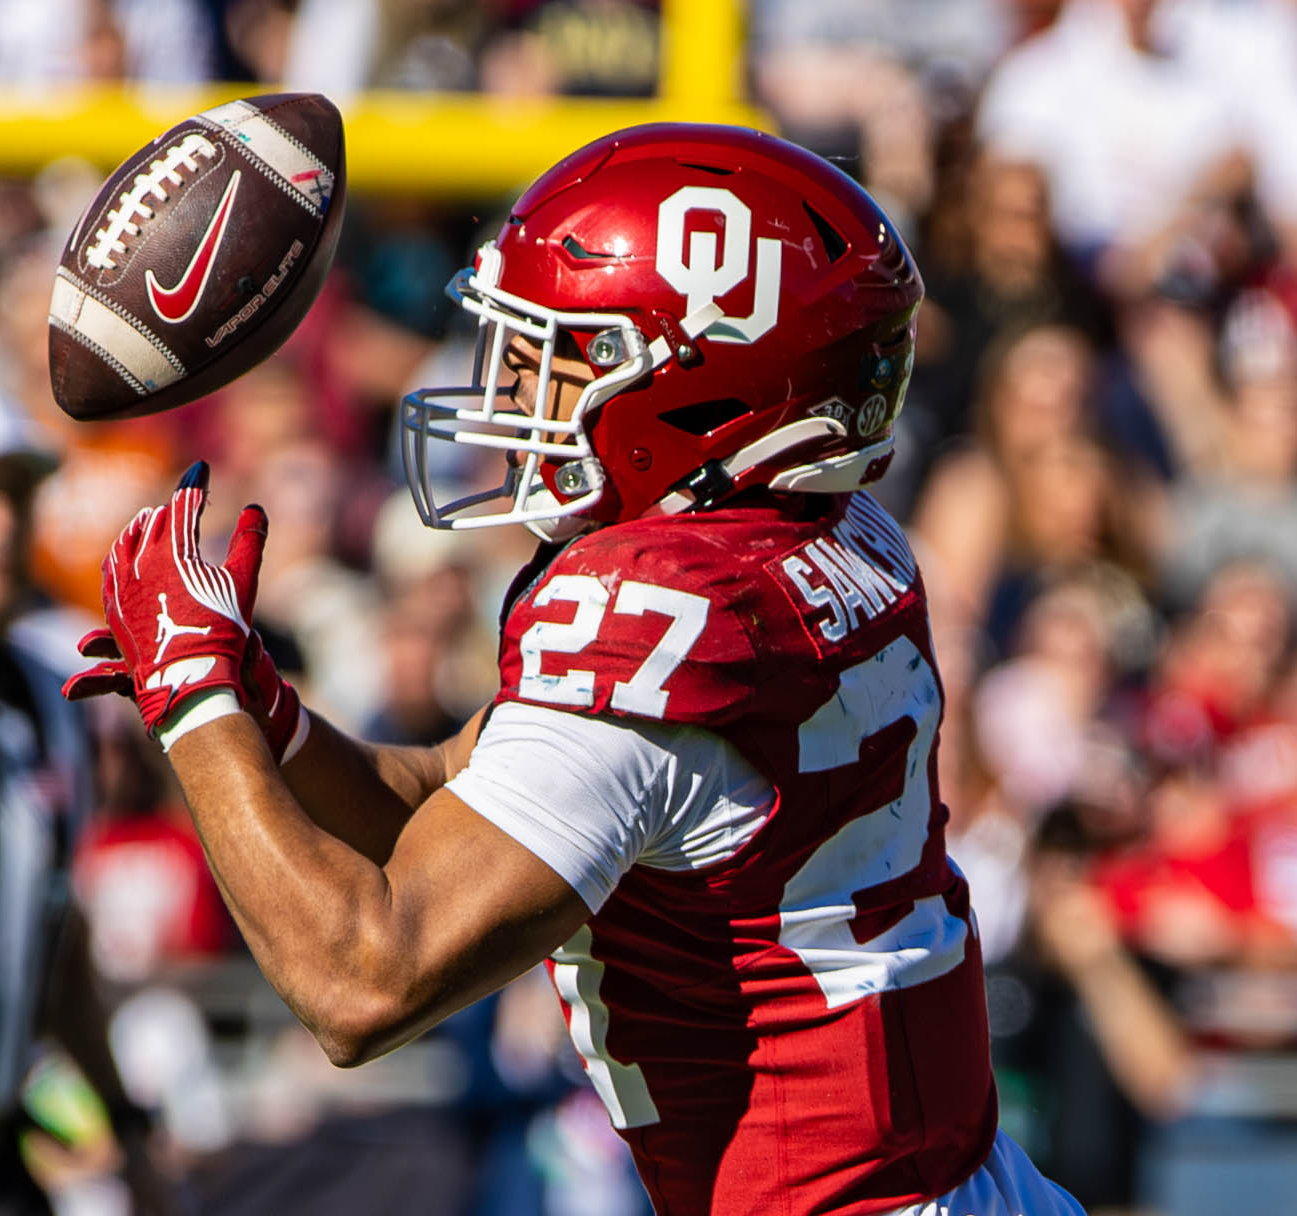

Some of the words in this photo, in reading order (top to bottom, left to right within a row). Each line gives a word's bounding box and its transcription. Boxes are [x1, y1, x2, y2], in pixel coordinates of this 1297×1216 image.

[203, 293, 267, 349] VAPOR
[261, 238, 305, 298] ELITE
[655, 185, 783, 345] OU
[519, 574, 711, 719] 27
